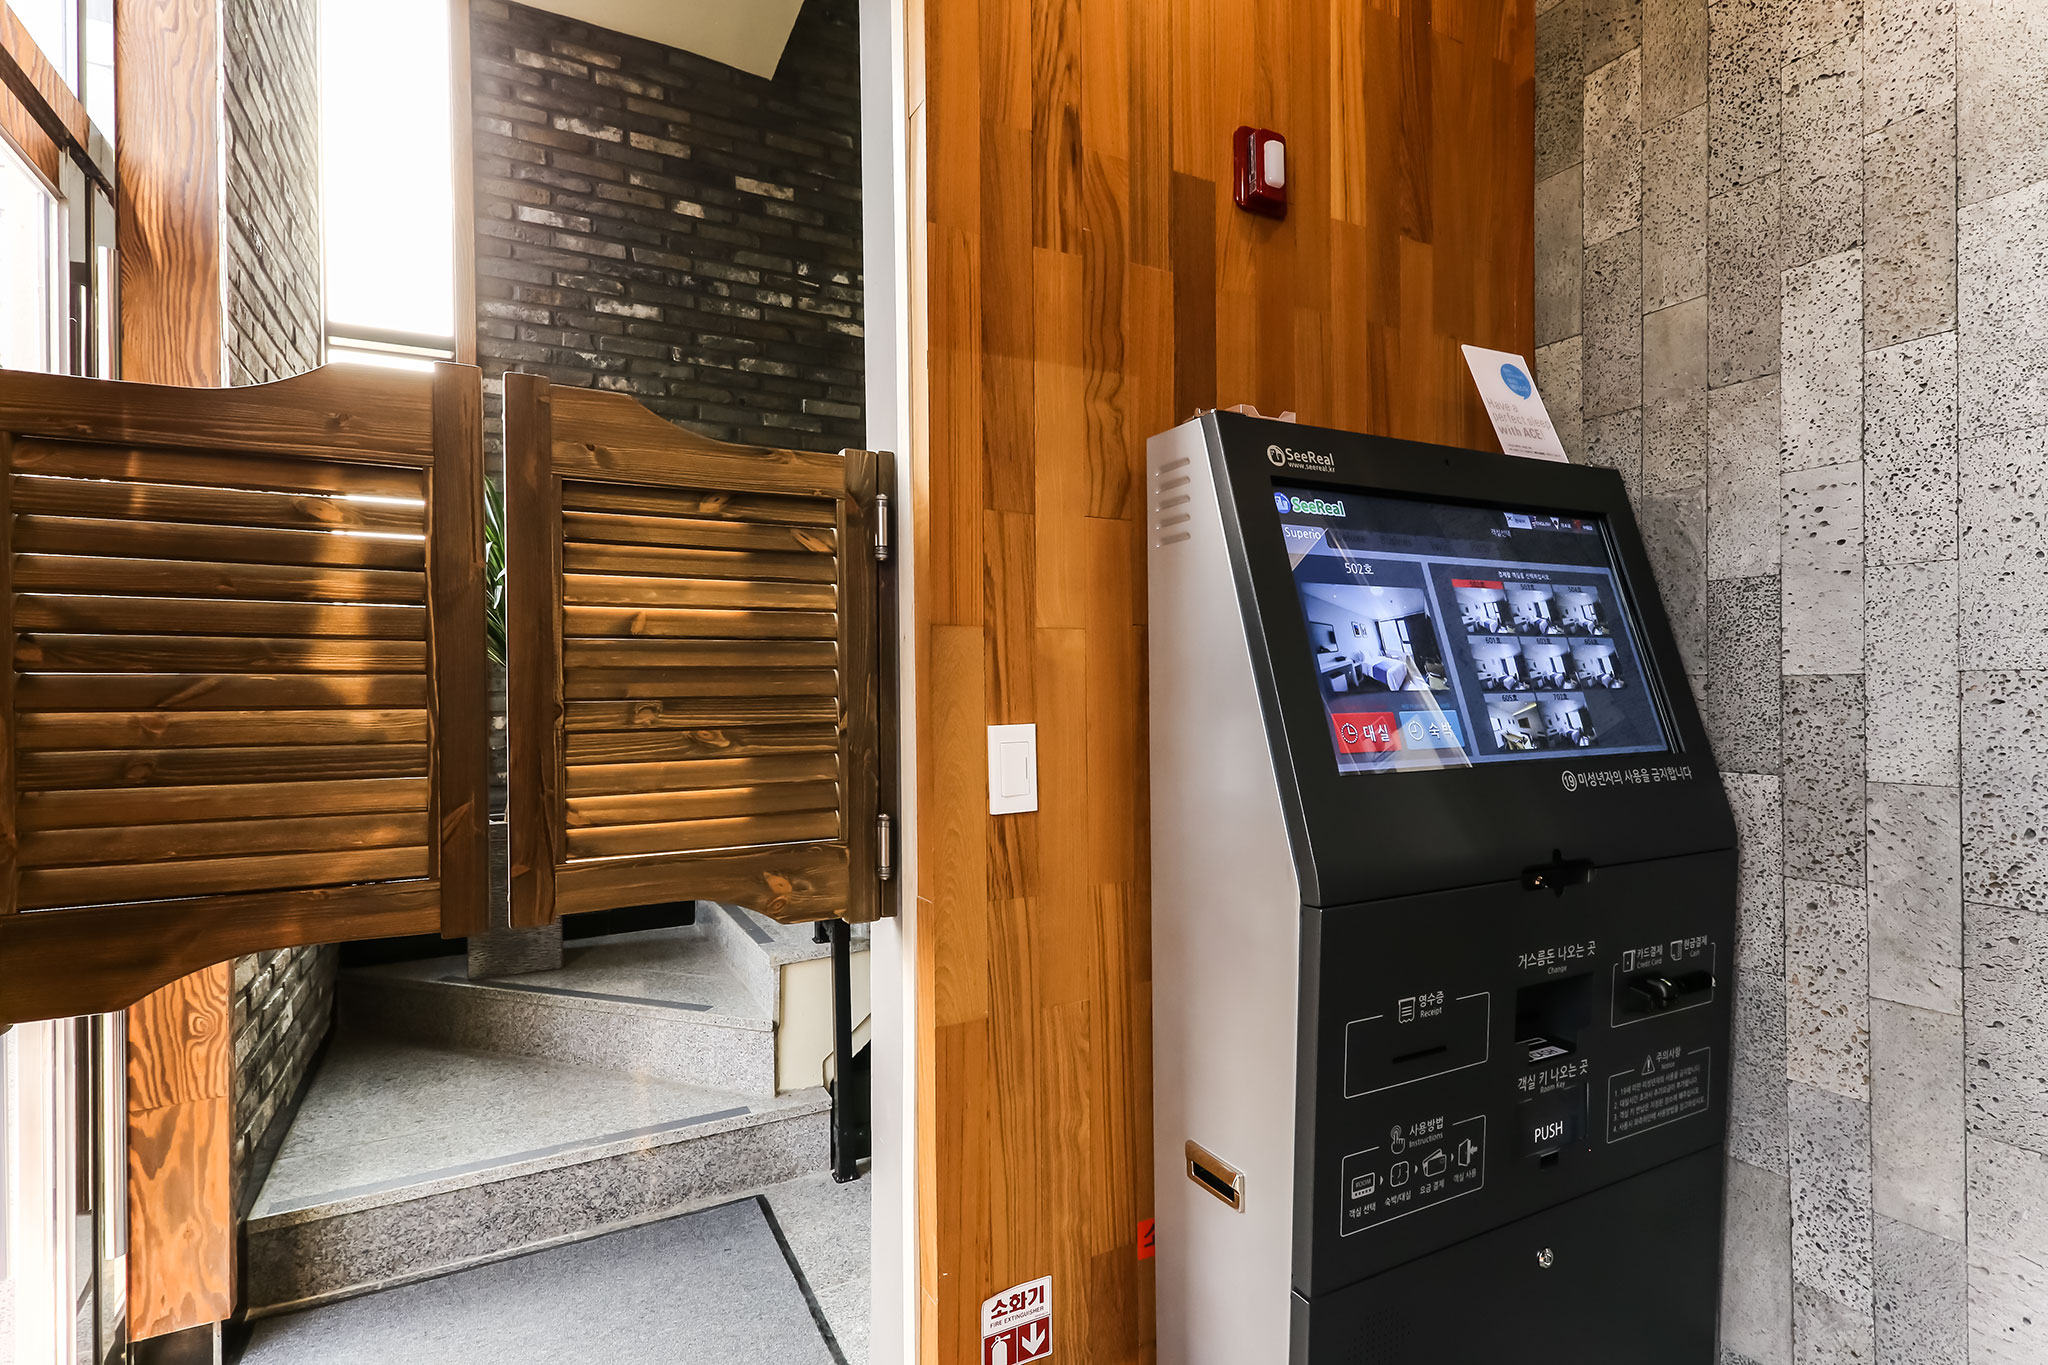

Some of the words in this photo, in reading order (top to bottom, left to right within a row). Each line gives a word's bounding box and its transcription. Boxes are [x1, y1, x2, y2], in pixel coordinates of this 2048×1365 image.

[1486, 398, 1511, 412] Have
[1512, 404, 1518, 413] a
[1492, 411, 1527, 426] perfect
[1526, 416, 1551, 430] sleep
[1499, 425, 1522, 437] with
[1285, 448, 1335, 466] SeeReal
[1288, 461, 1335, 473] www.seereal.kr
[1290, 497, 1346, 517] SeeReal
[1284, 526, 1321, 540] Superio
[1345, 562, 1374, 575] 502호
[1362, 724, 1391, 743] 대실
[1428, 722, 1454, 740] 숙박
[1577, 770, 1623, 788] 미성년자의
[1624, 768, 1650, 784] 사용을
[1651, 765, 1693, 783] 금지합니다
[1518, 948, 1555, 969] 거스름돈
[1558, 943, 1584, 961] 나오는
[1587, 940, 1596, 956] 곳
[1547, 965, 1567, 974] Change
[1418, 991, 1444, 1008] 영수증
[1420, 1007, 1442, 1018] Receipt
[1518, 1074, 1536, 1091] 객실
[1539, 1070, 1548, 1085] 키
[1550, 1063, 1577, 1082] 나오는
[1579, 1059, 1588, 1075] 곳
[1409, 1116, 1444, 1136] 사용방법
[1534, 1120, 1563, 1143] PUSH
[1409, 1132, 1443, 1148] Instructions
[1419, 1184, 1431, 1195] 요금
[991, 1284, 1044, 1320] 소화기
[990, 1319, 1002, 1329] FIRE
[1004, 1305, 1044, 1324] EXTINGUISHER
